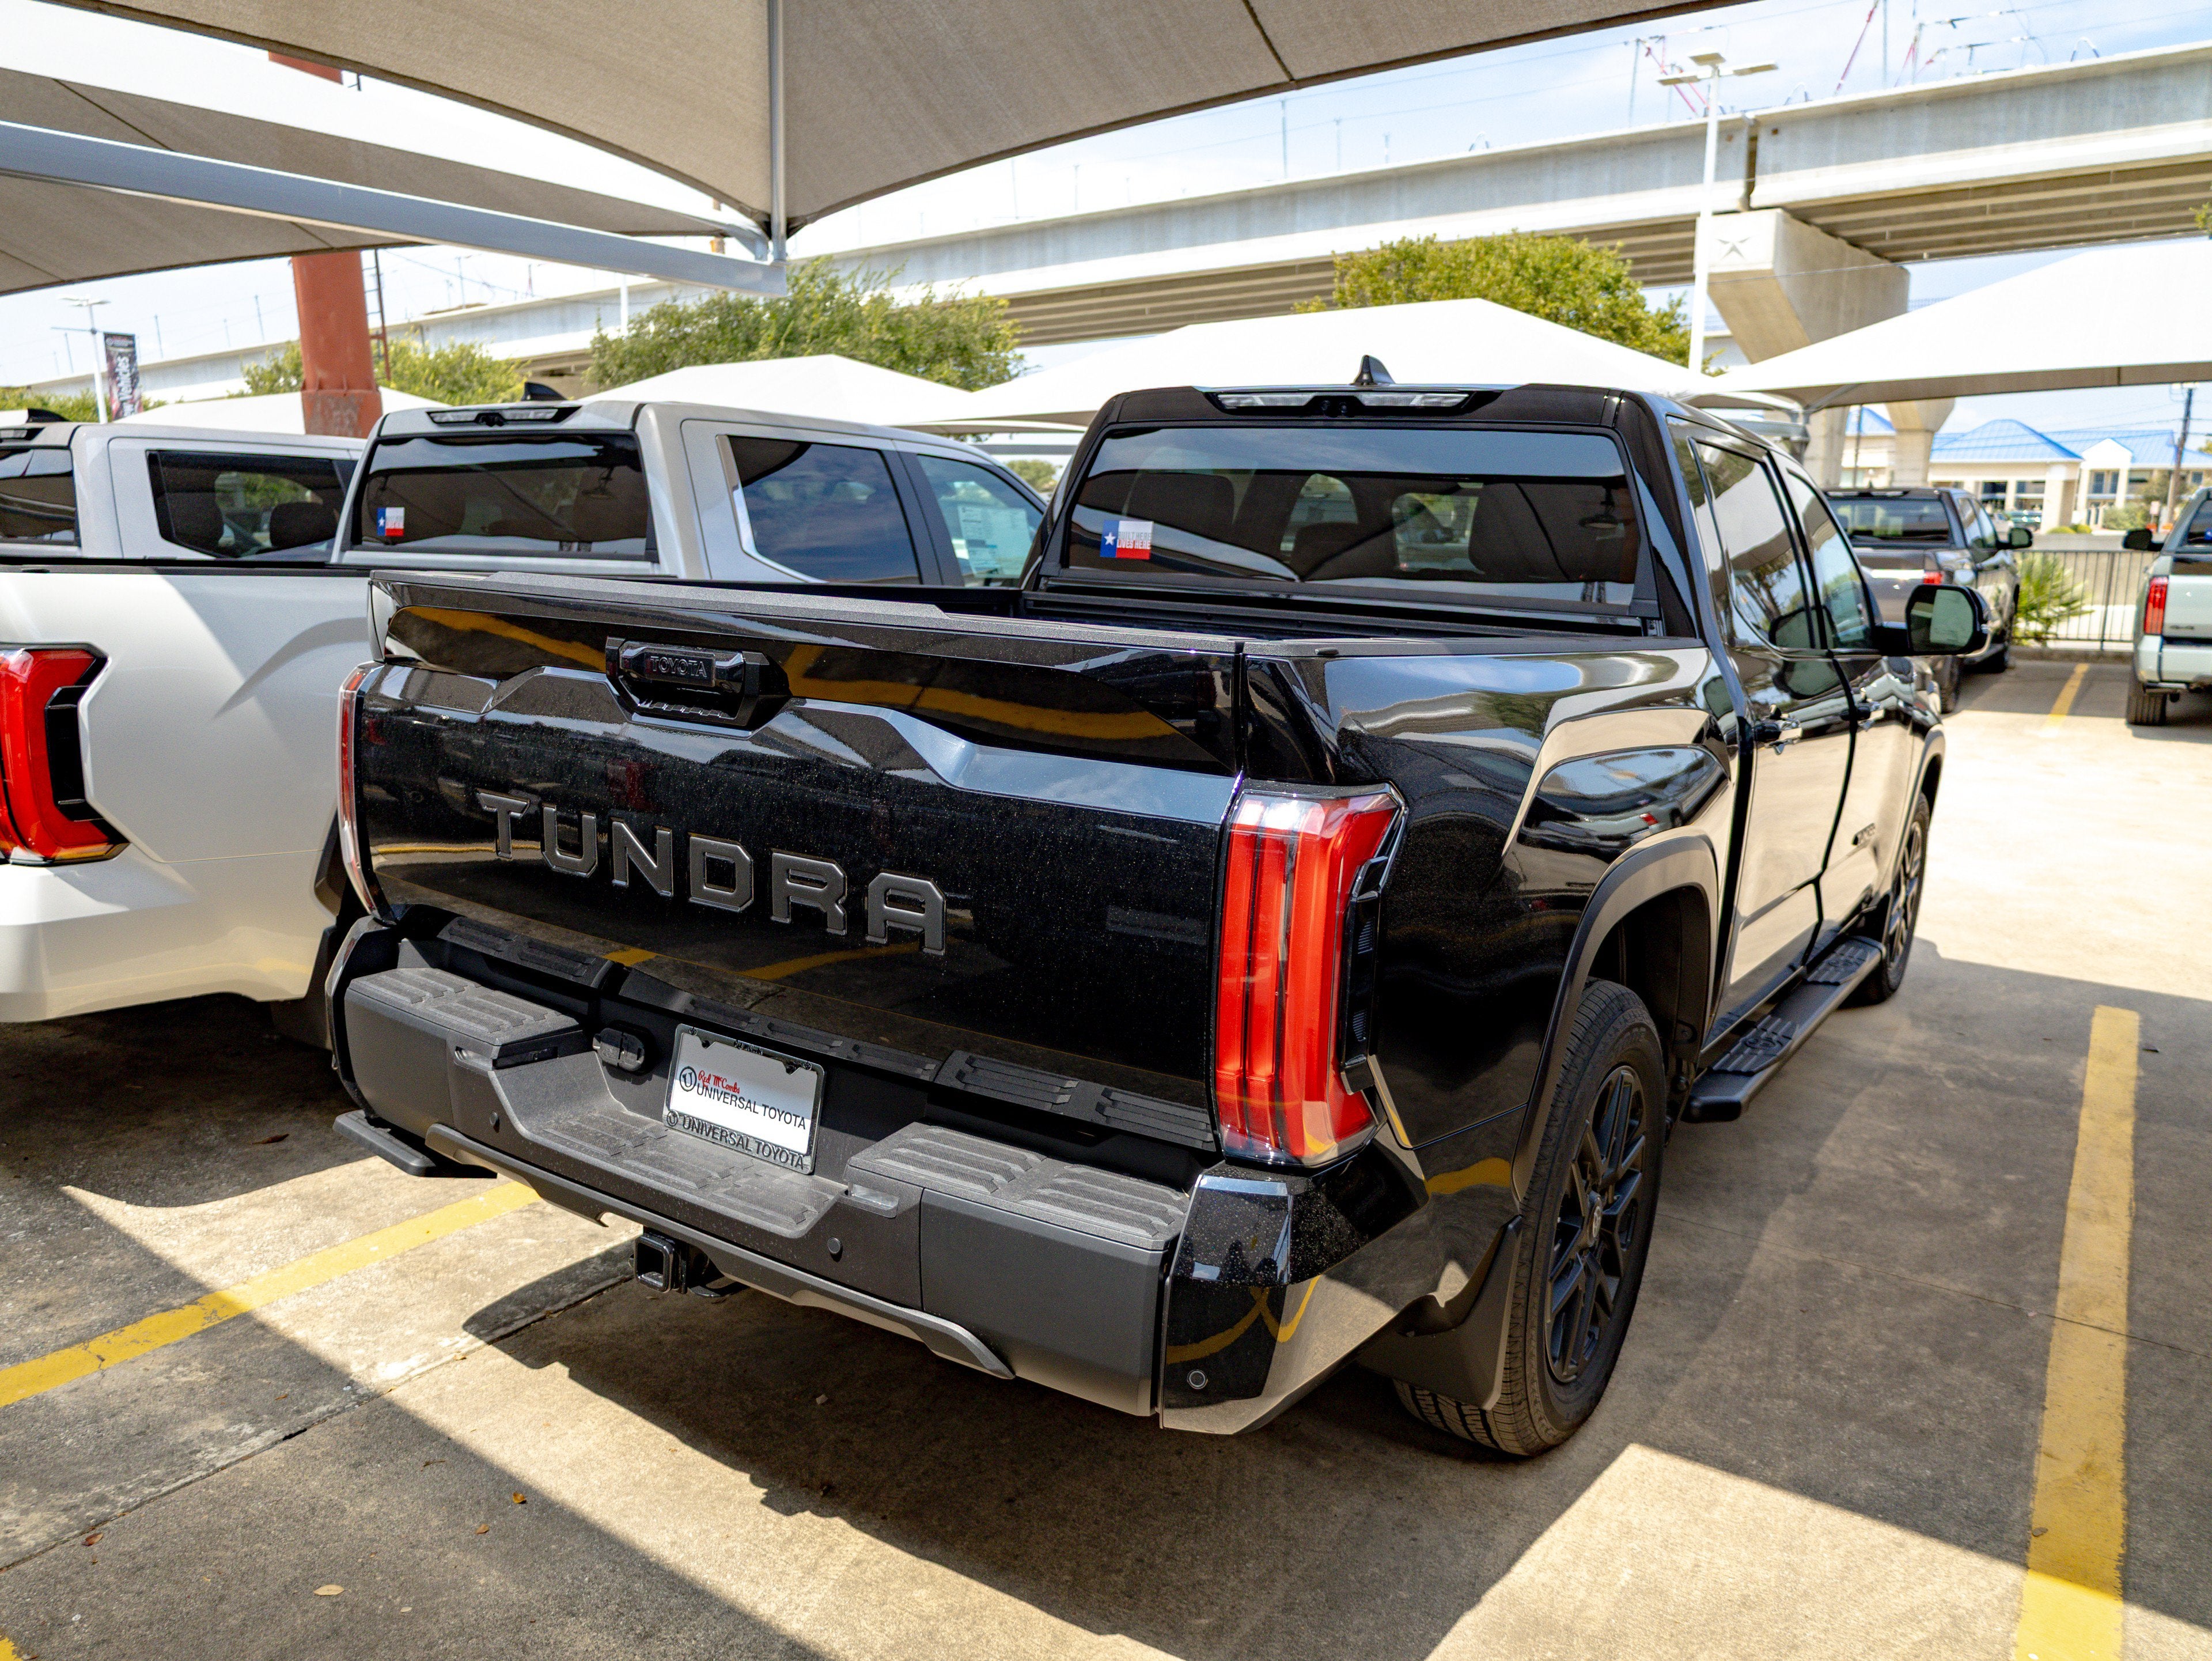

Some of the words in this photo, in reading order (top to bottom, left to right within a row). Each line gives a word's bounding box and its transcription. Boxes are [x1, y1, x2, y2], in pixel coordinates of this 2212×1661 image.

[1116, 539, 1133, 548] LIVES
[1134, 540, 1151, 550] HERE
[1136, 532, 1151, 540] HERE
[650, 656, 707, 678] TOYOTA
[475, 787, 946, 956] TUNDRA
[698, 1070, 710, 1087] Red
[713, 1074, 740, 1094] McCombs
[697, 1083, 759, 1114] UNIVERSAL
[762, 1104, 806, 1130] TOYOTA
[682, 1114, 753, 1153] UNIVERSAL
[755, 1140, 804, 1170] TOYOTA
